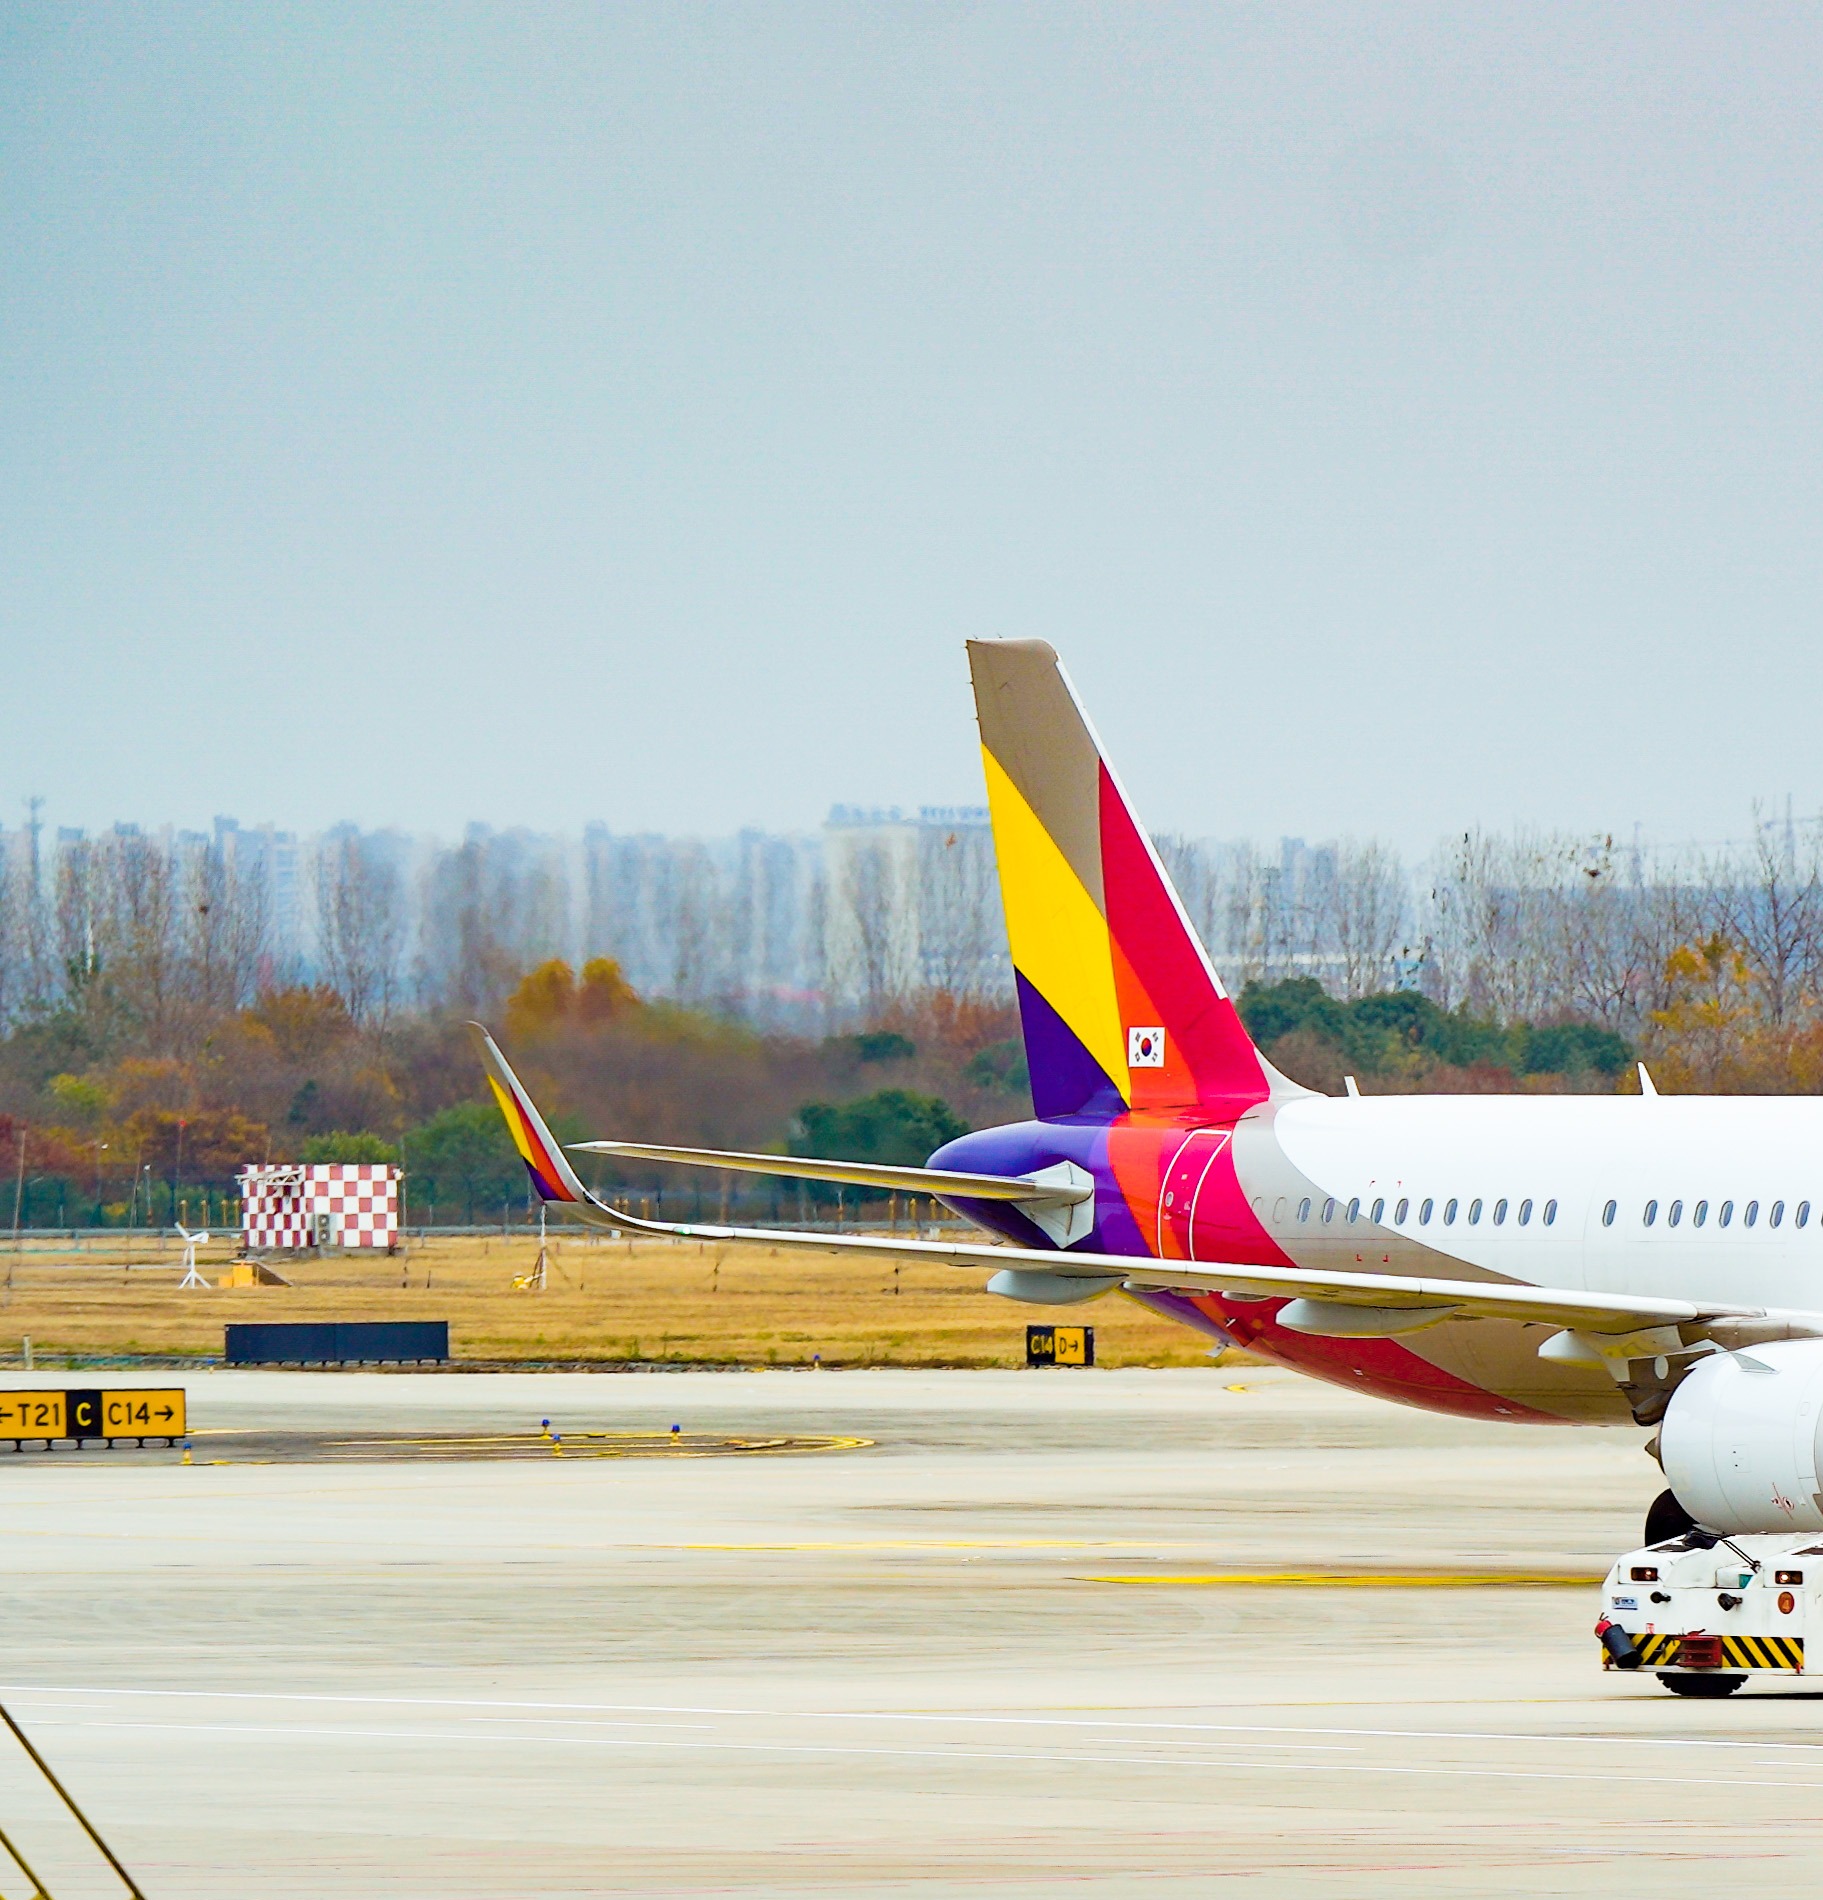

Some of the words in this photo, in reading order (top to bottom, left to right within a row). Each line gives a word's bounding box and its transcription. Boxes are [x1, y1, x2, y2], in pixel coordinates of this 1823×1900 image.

[1059, 1337, 1068, 1355] D
[17, 1403, 60, 1427] T21
[76, 1402, 92, 1427] C
[108, 1402, 150, 1426] C14
